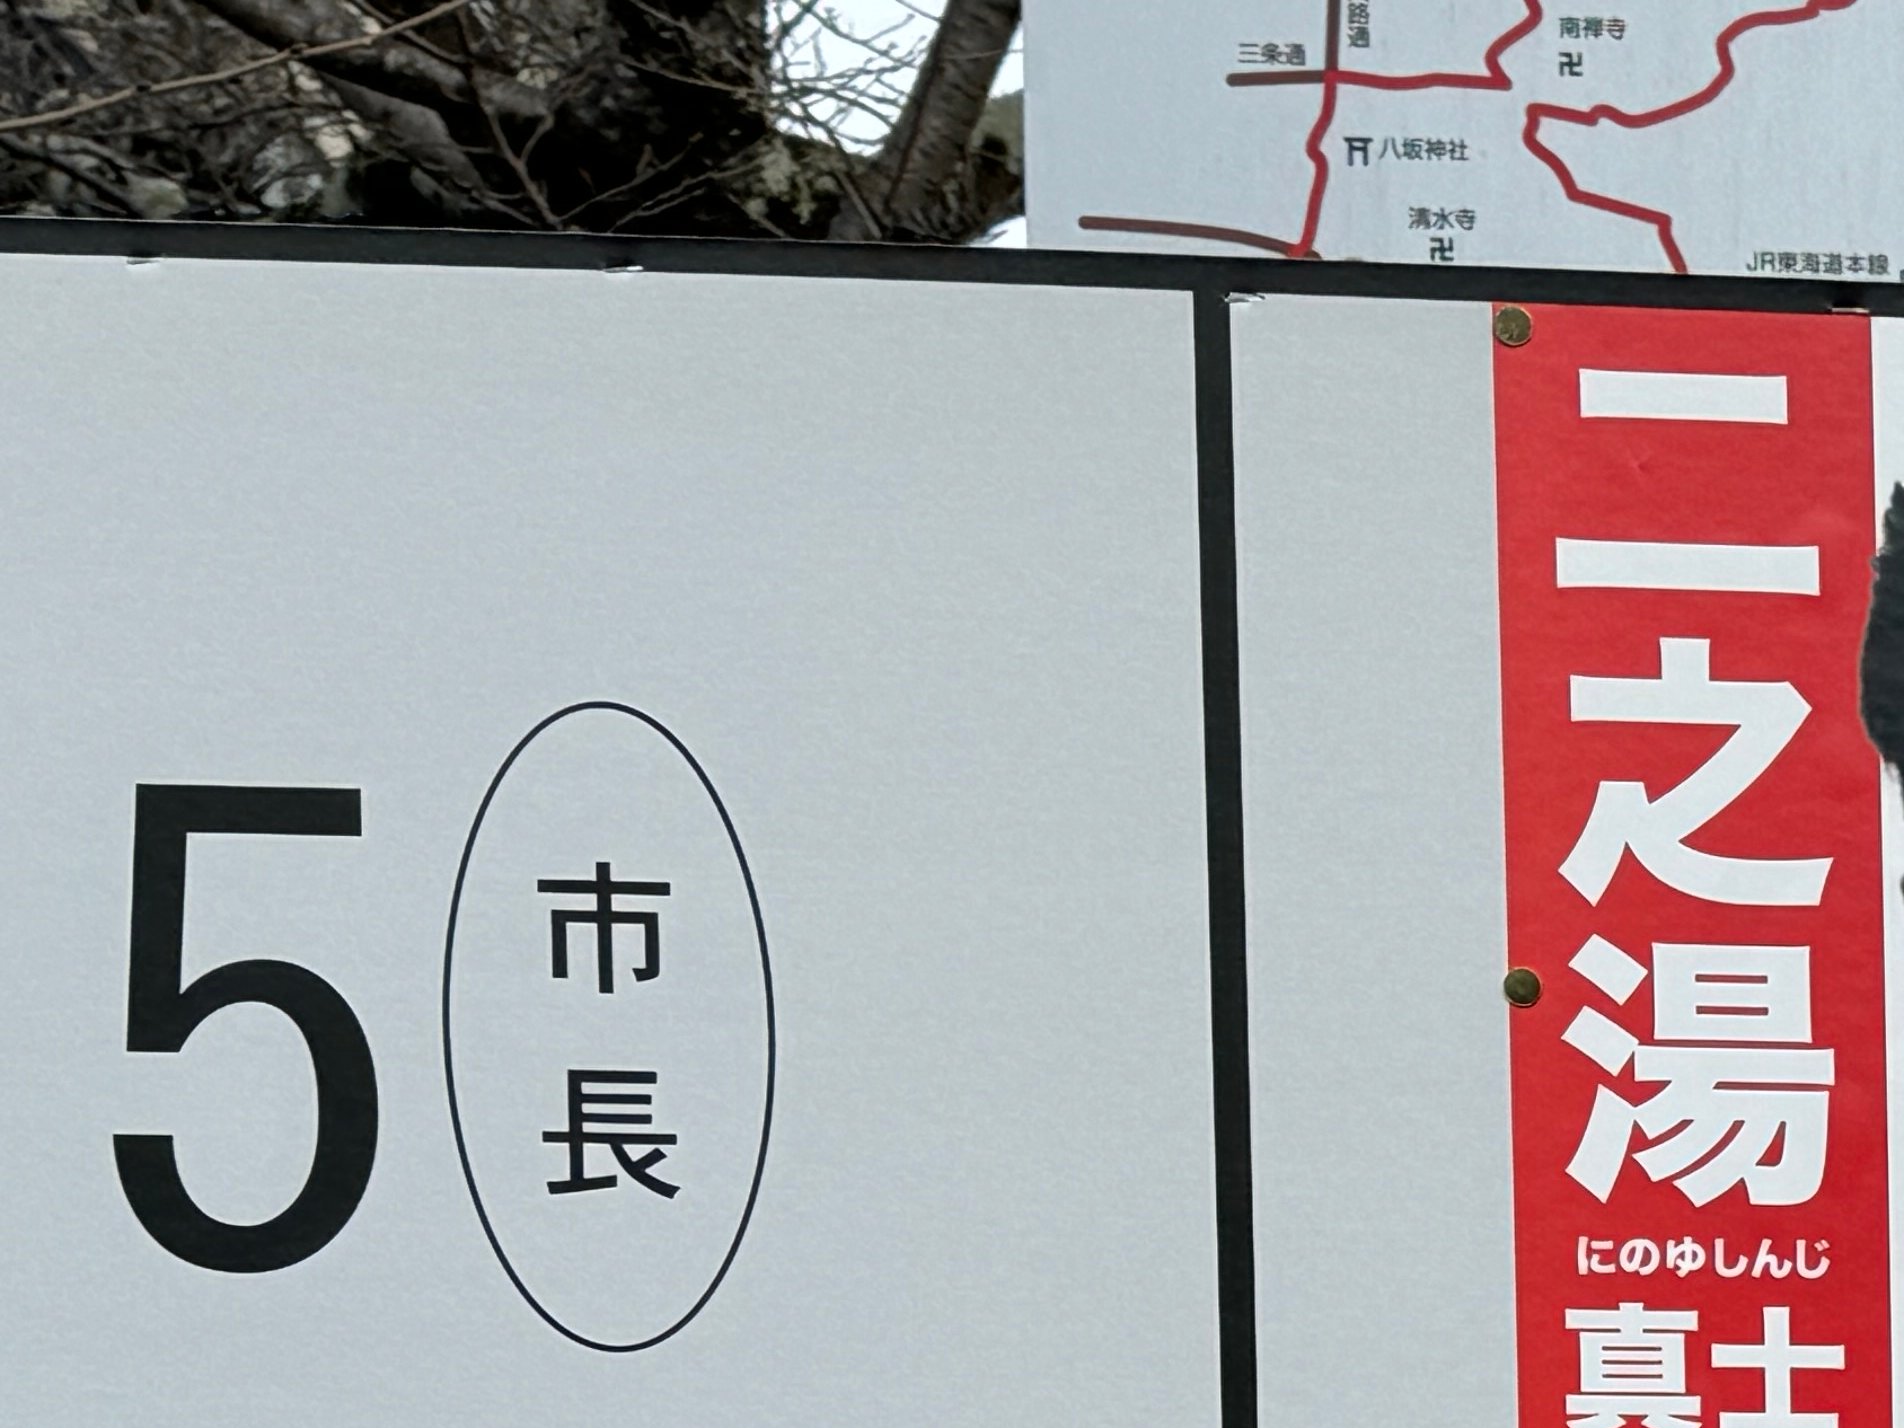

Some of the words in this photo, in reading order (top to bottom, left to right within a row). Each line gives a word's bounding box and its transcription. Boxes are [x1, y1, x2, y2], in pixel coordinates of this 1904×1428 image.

[1237, 42, 1307, 67] 三条通
[1378, 137, 1470, 162] 八坂神社
[1408, 206, 1477, 231] 清水寺
[1746, 250, 1890, 276] JR東海道本線
[1554, 367, 1836, 1210] 二之湯
[110, 780, 381, 1274] 5
[536, 860, 683, 1202] 市長
[1575, 1234, 1832, 1282] にのゆしんじ
